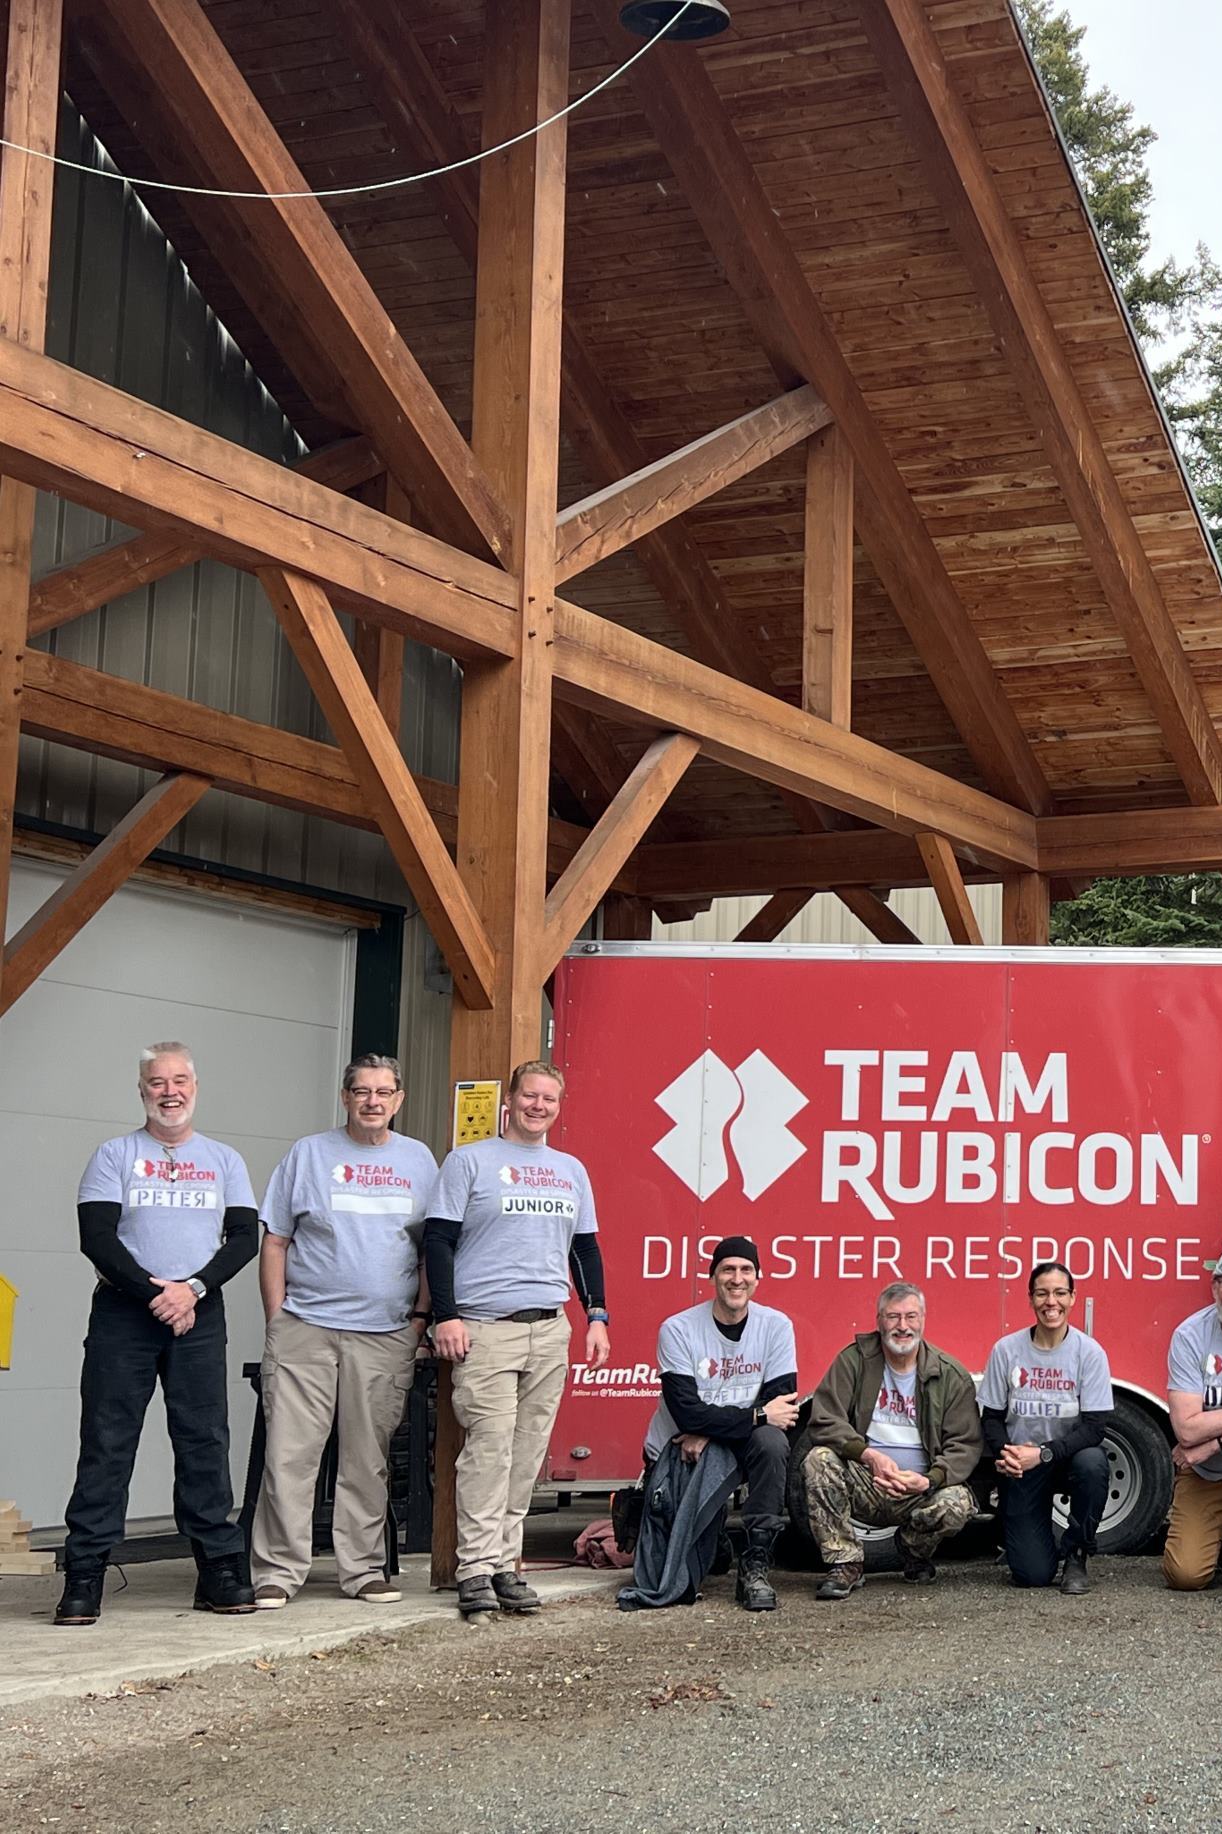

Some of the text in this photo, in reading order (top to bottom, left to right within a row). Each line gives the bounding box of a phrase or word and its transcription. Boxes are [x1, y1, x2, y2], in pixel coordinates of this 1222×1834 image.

[822, 1049, 1069, 1123] TEAM
[157, 1161, 195, 1171] TEAM
[356, 1164, 393, 1175] TEAM
[521, 1166, 556, 1177] TEAM
[356, 1175, 412, 1189] RUBICON
[821, 1130, 1198, 1221] RUBICON
[523, 1177, 573, 1191] RUBICON
[504, 1199, 564, 1214] JUNIOR
[642, 1235, 1201, 1281] DISSTER RESPONSE
[571, 1363, 662, 1385] TeamRu
[1032, 1367, 1063, 1378] TEAM
[1030, 1379, 1076, 1391] RUBICON
[1012, 1401, 1061, 1416] JULIET
